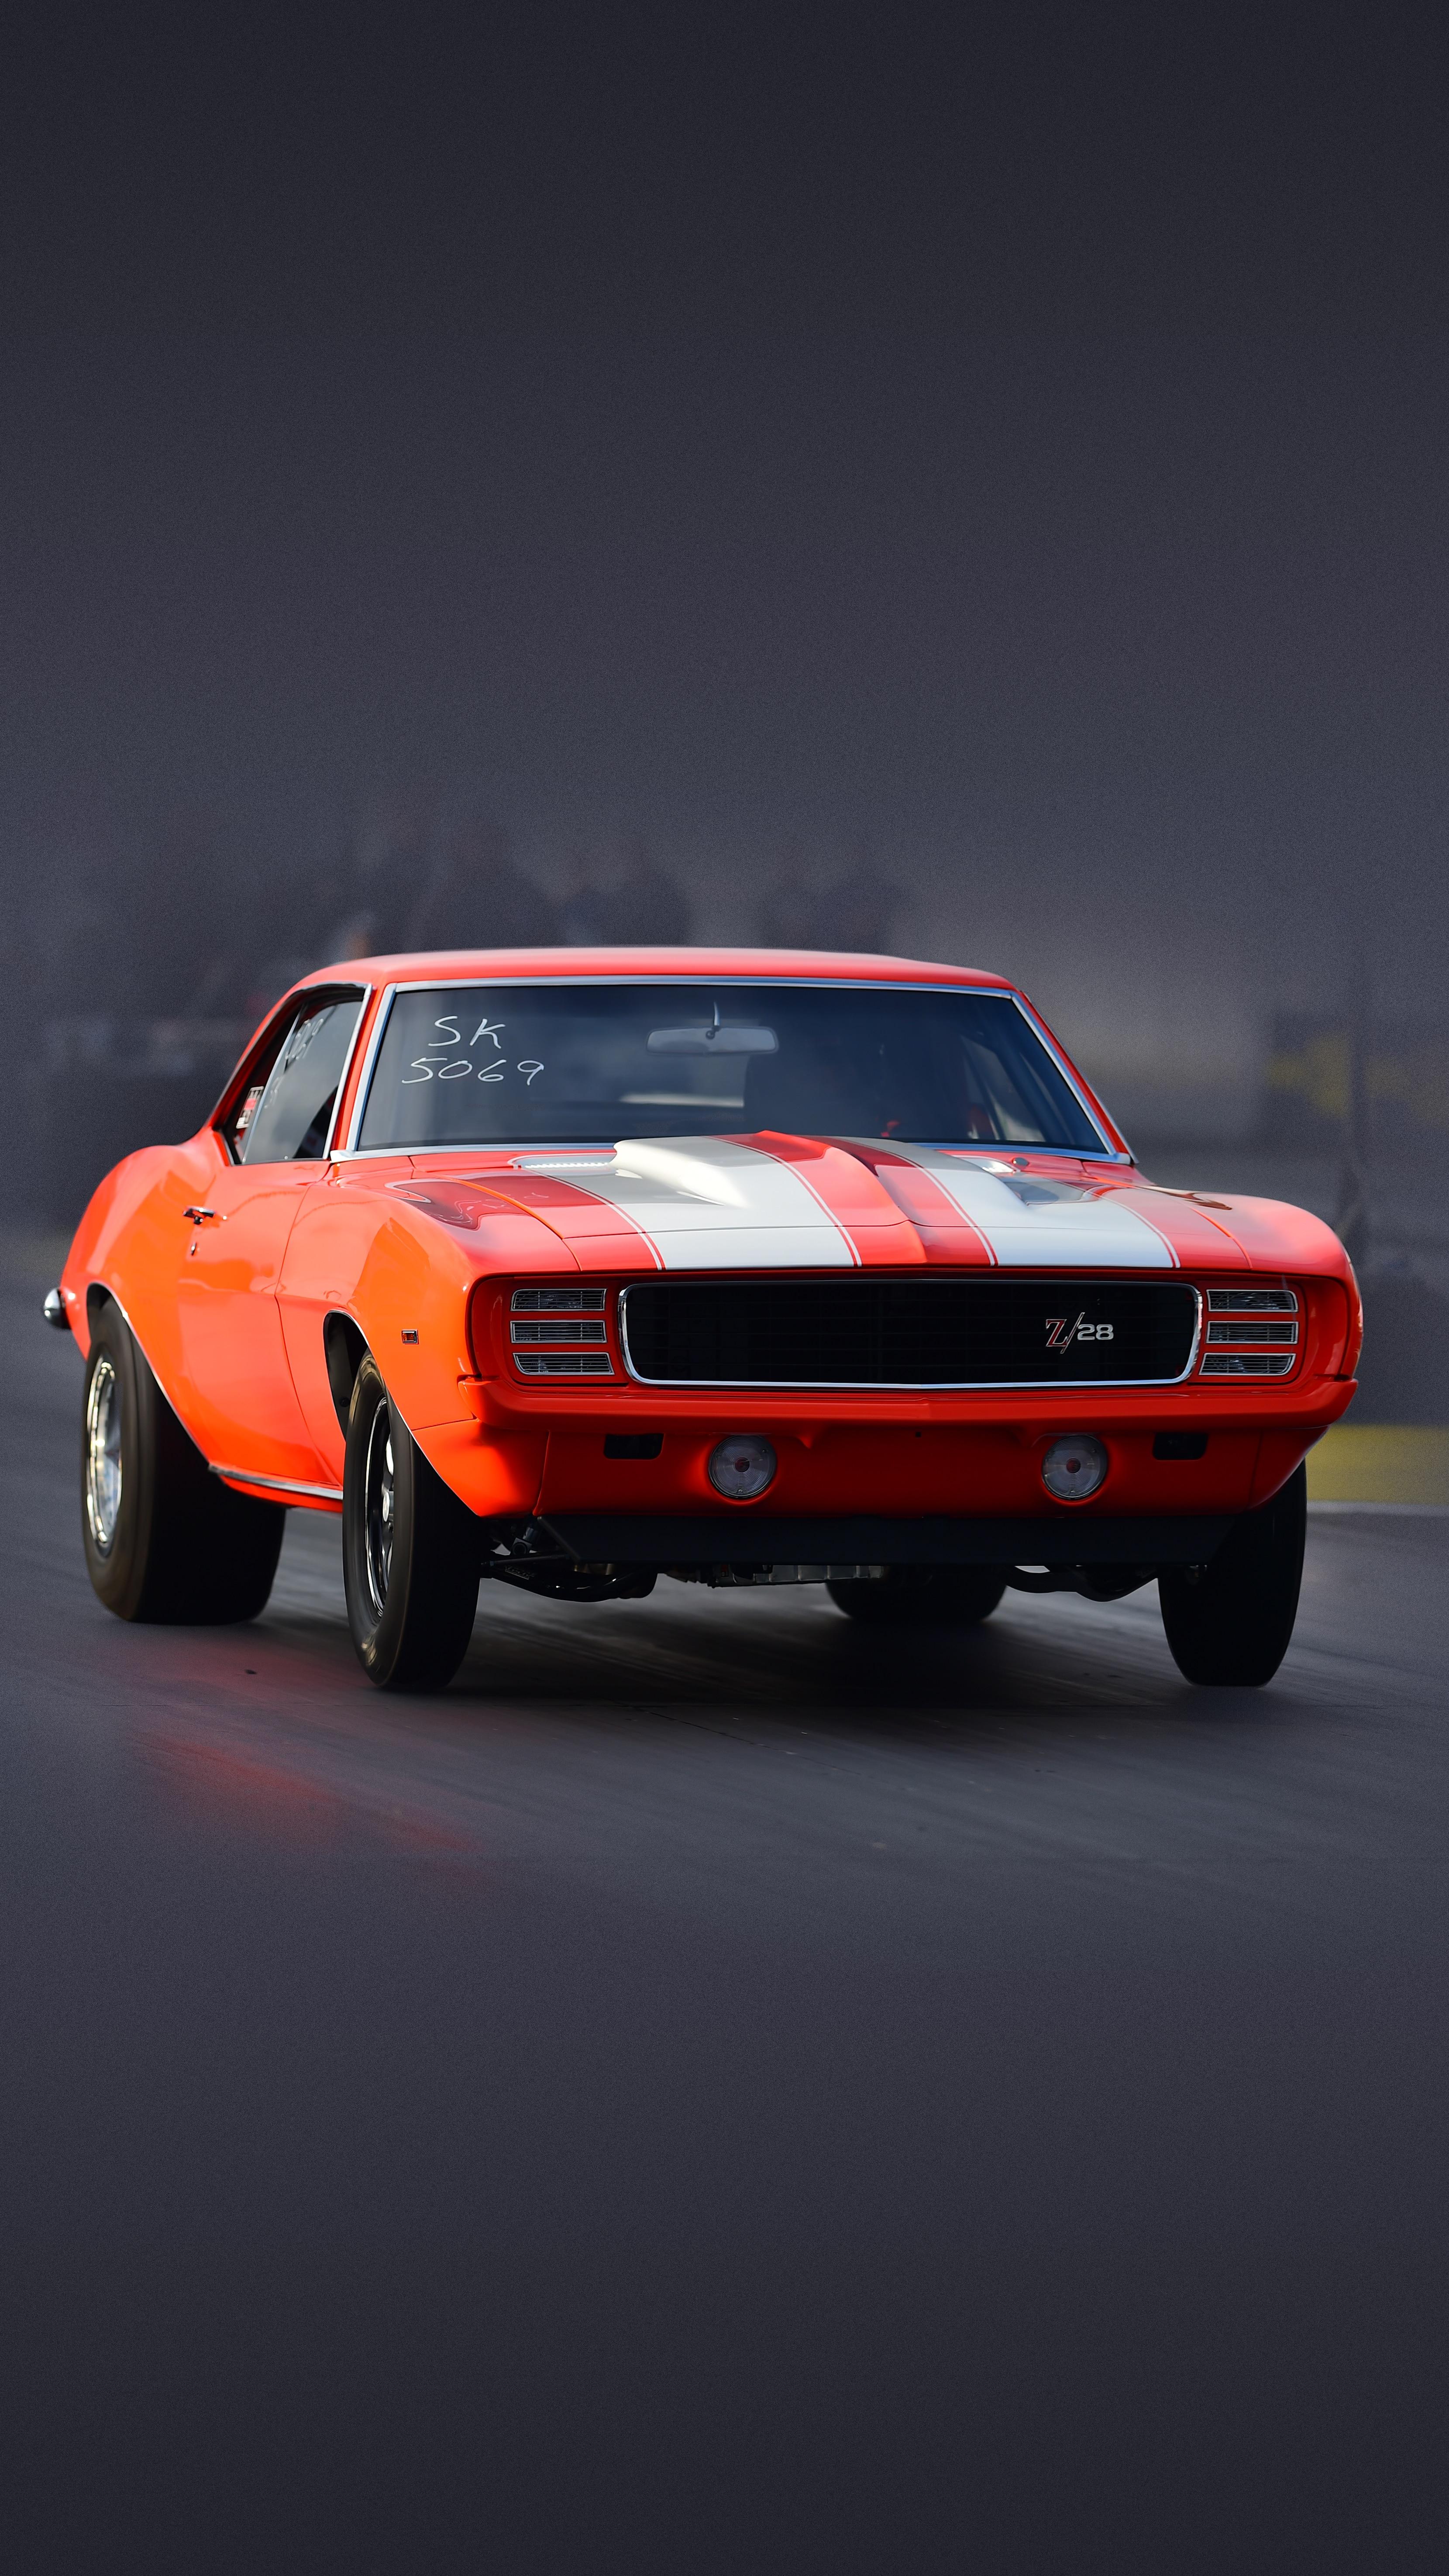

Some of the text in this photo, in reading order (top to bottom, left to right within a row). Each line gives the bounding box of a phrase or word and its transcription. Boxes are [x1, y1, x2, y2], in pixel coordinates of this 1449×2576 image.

[428, 1016, 506, 1049] SK
[402, 1057, 544, 1086] 5069
[1046, 1312, 1114, 1354] Z/28
